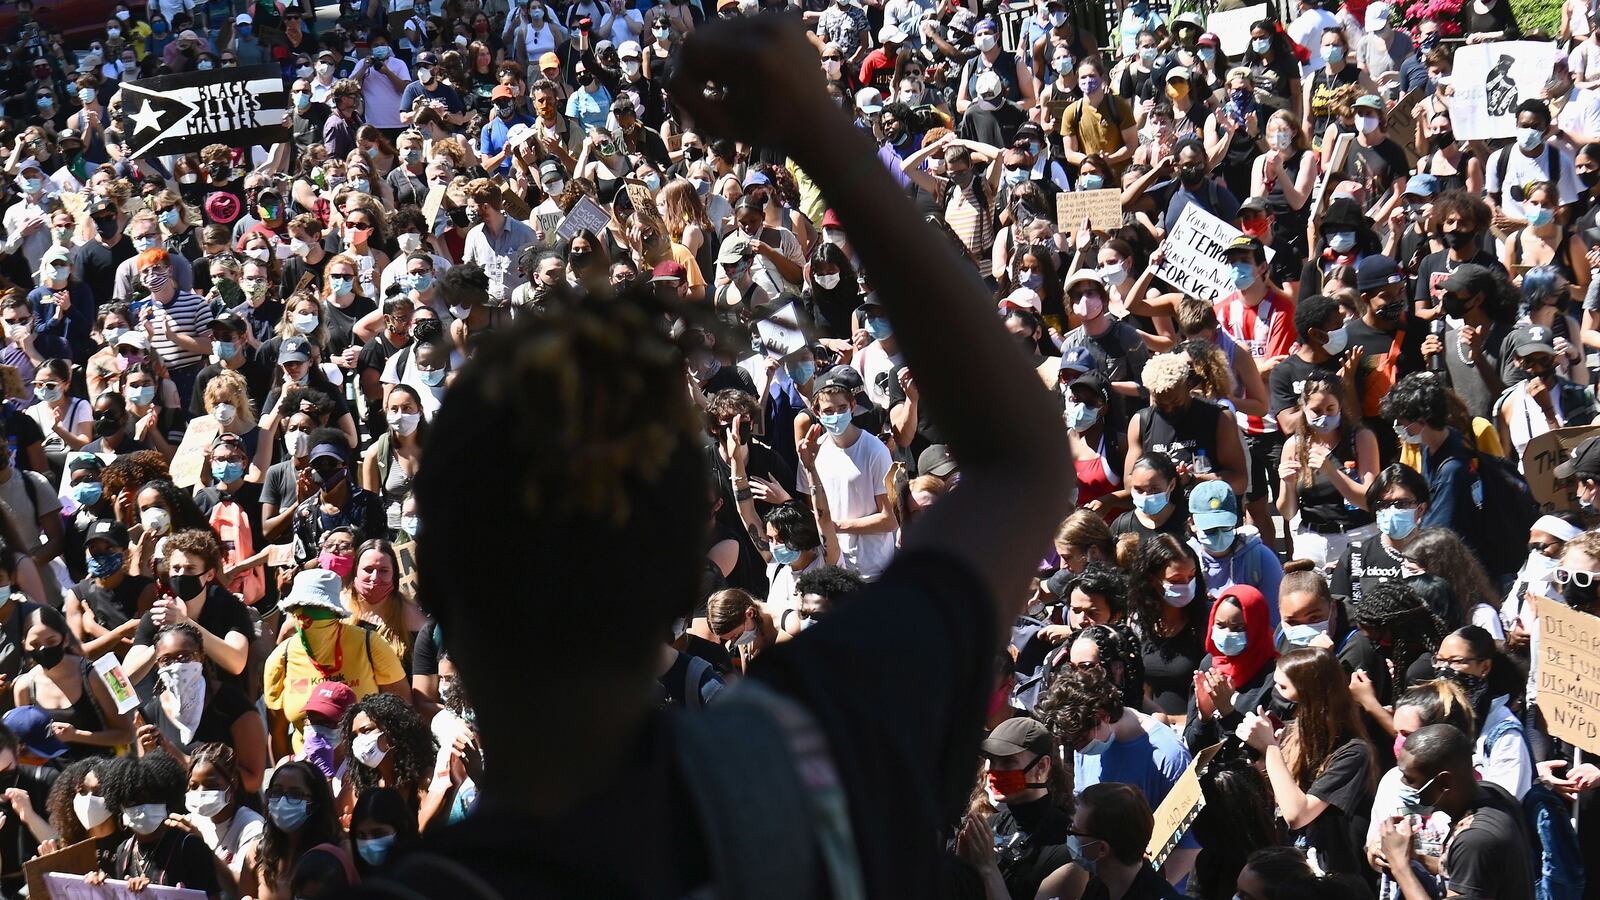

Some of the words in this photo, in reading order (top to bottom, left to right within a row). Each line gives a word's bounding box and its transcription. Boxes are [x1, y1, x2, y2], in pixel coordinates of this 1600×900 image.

[199, 79, 252, 102] BLACK
[204, 93, 261, 117] LIVES
[187, 111, 260, 135] MATTER
[536, 213, 561, 232] Yello
[566, 205, 588, 231] BLACK
[576, 213, 595, 232] IVES
[590, 217, 604, 231] TER
[1155, 259, 1219, 301] FOREVER
[1367, 566, 1401, 578] bloody
[1567, 701, 1584, 714] THE
[1554, 707, 1598, 739] NYPD
